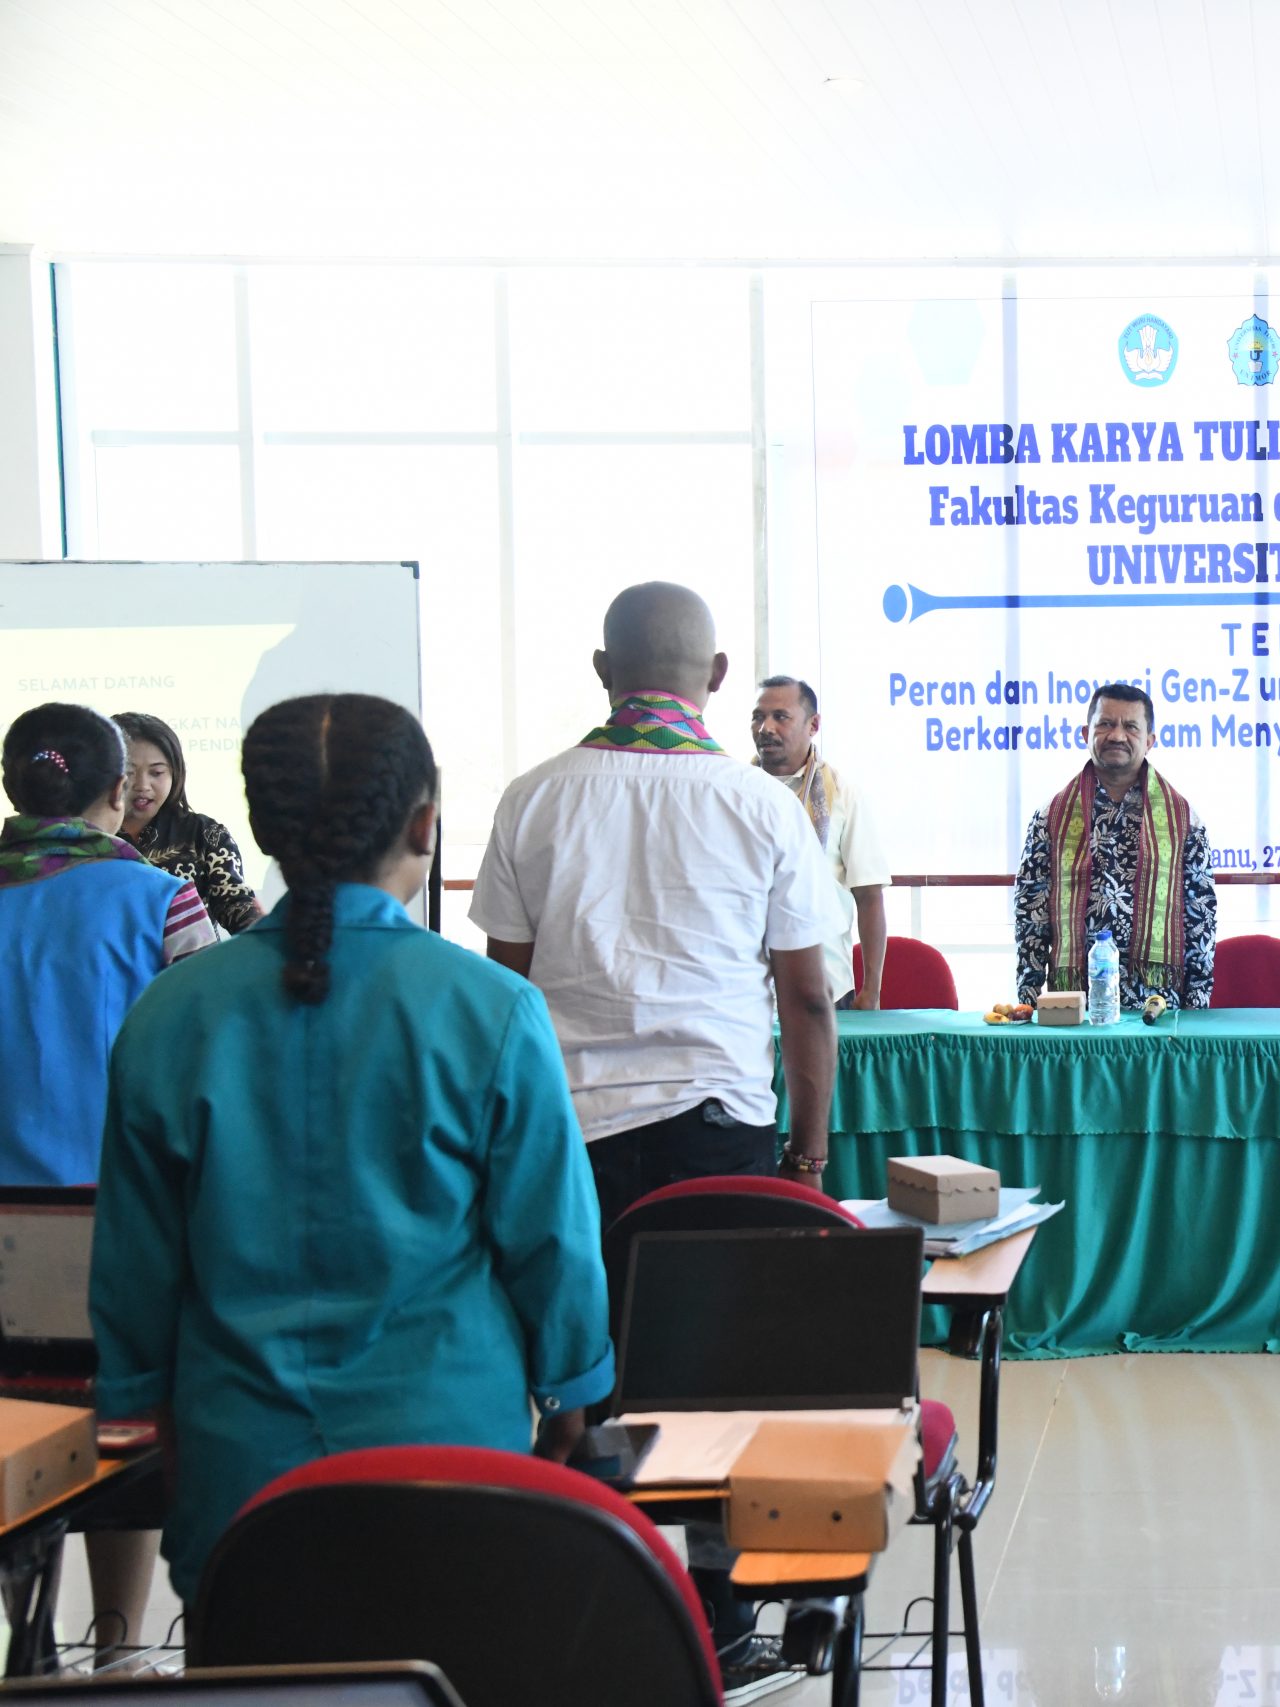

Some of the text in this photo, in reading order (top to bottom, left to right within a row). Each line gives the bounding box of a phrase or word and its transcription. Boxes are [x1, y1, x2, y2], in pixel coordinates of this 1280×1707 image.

[902, 423, 1041, 466] LOMBA
[1051, 421, 1184, 464] KARYA
[928, 484, 1079, 527] Fakultas
[1089, 483, 1265, 535] Keguruan
[18, 675, 176, 692] SELAMAT DATANG
[889, 672, 976, 707] Peran
[985, 669, 1038, 705] dan
[1161, 668, 1250, 703] Gen-Z
[169, 716, 211, 731] GKAT
[926, 715, 1087, 752] Berkarakte
[1211, 848, 1258, 872] anu,
